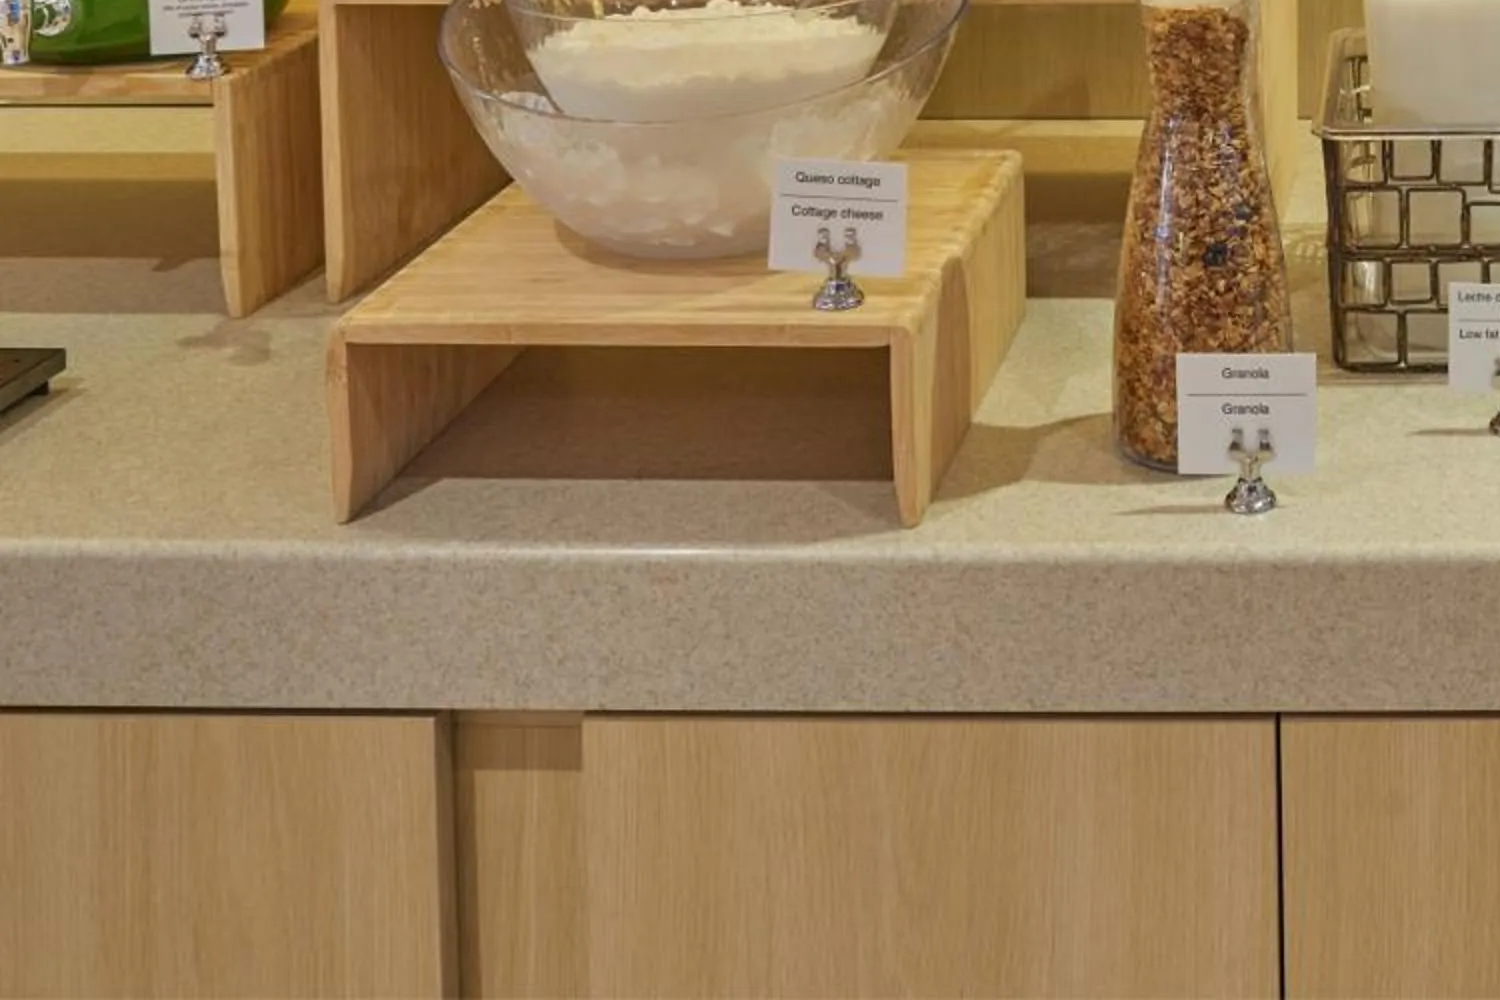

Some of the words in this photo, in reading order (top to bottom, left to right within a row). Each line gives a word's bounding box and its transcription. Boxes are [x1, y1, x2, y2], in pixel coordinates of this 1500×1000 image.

[795, 171, 834, 184] Queso
[837, 174, 881, 189] cottage
[791, 204, 837, 220] Cottage
[840, 207, 883, 220] cheese
[1458, 291, 1492, 303] Leche
[1459, 328, 1483, 340] Low
[1485, 328, 1499, 340] fat
[1221, 367, 1270, 379] Granola
[1221, 402, 1270, 415] Granola
